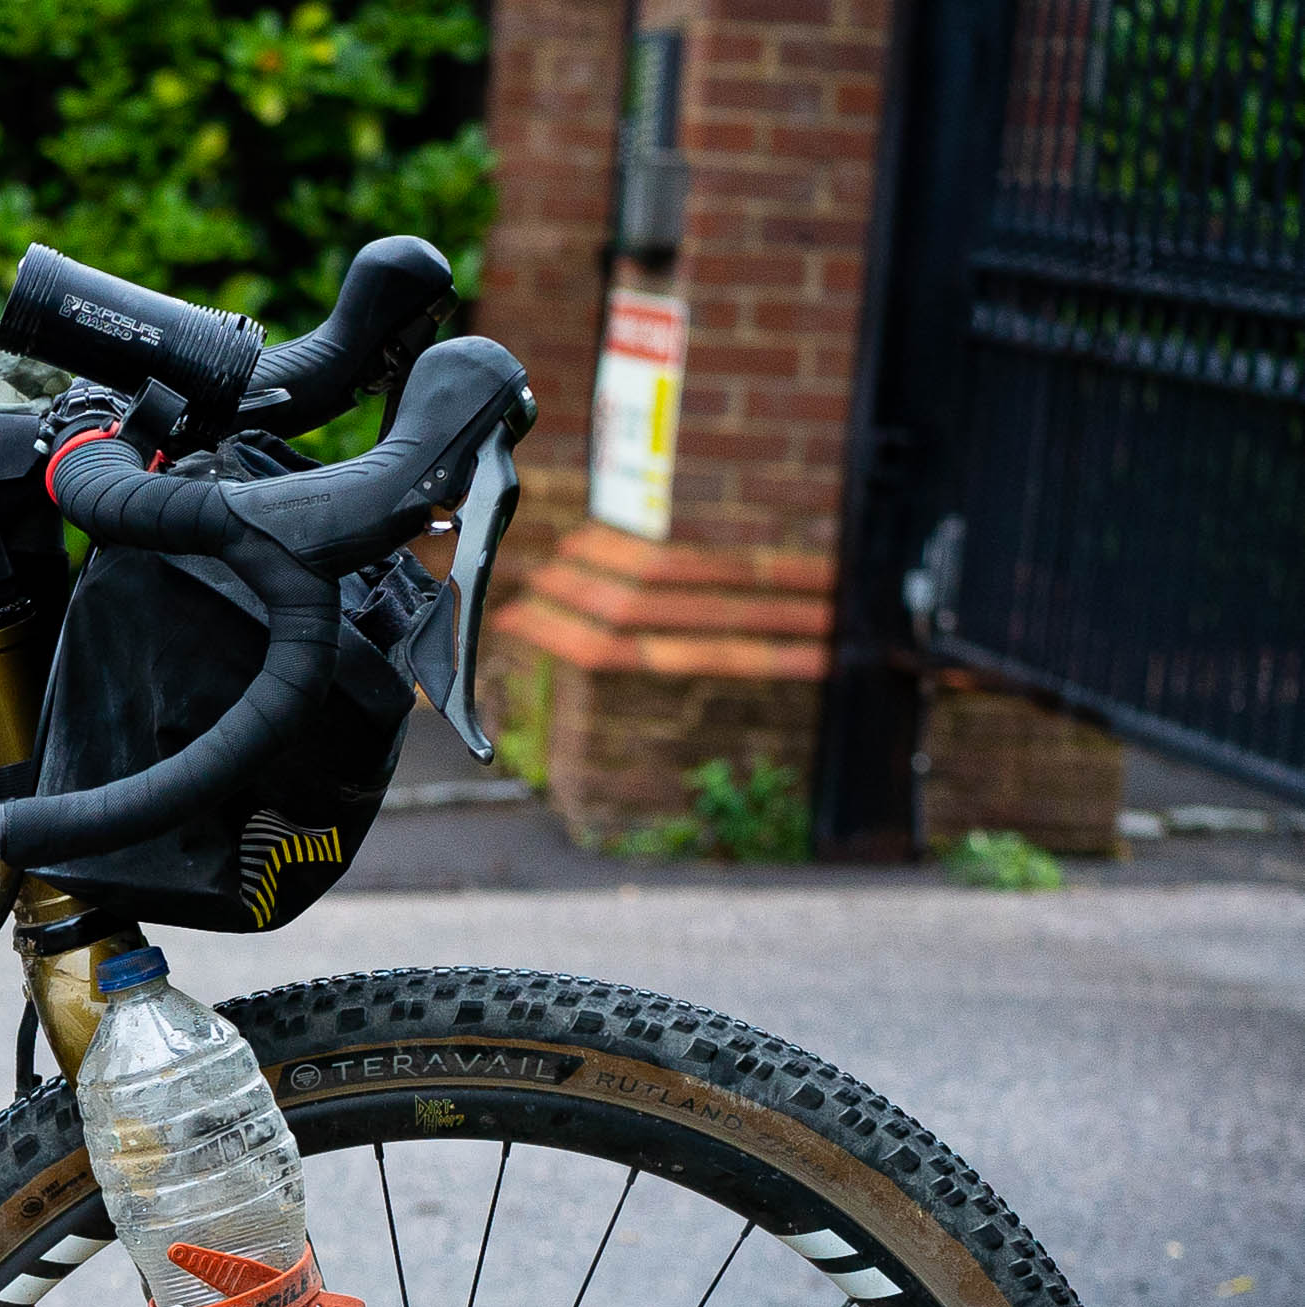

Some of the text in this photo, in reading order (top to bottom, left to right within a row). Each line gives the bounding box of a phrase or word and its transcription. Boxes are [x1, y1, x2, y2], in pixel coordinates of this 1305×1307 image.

[81, 300, 164, 340] EXPOSURE
[332, 1052, 559, 1080] TERAVAIL
[595, 1071, 743, 1131] RUTLAND
